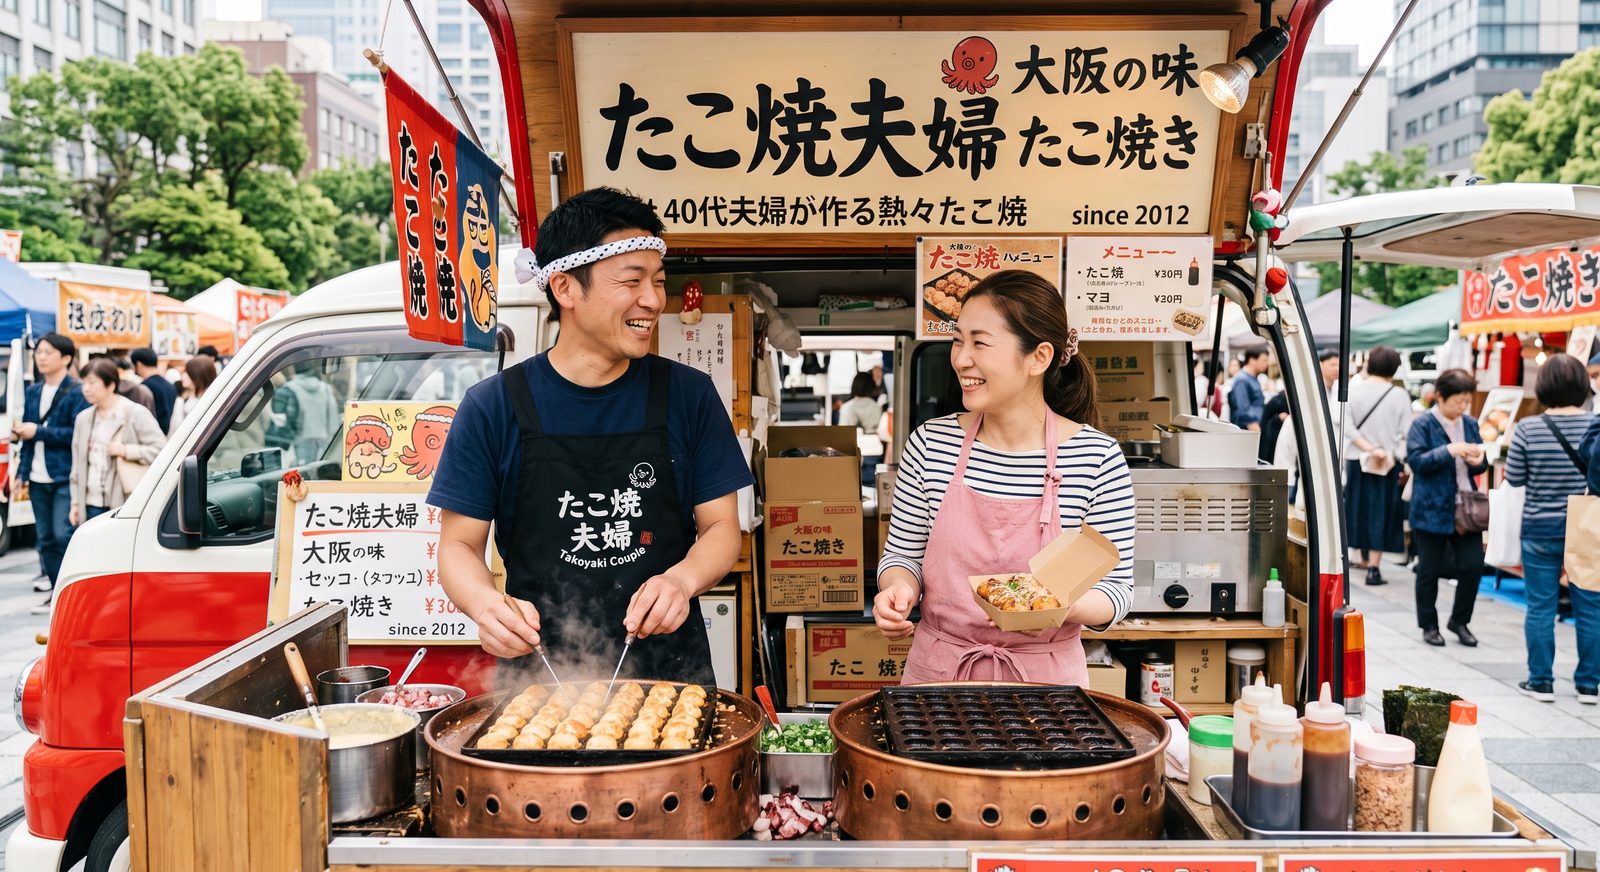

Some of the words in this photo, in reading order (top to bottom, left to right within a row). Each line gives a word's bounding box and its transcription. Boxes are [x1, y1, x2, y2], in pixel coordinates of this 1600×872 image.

[1011, 44, 1200, 96] 大阪の味
[599, 77, 1006, 181] たこ焼夫婦
[1019, 113, 1199, 171] たこ焼き
[397, 121, 428, 319] たこ焼
[1072, 206, 1129, 226] since
[1135, 204, 1190, 226] 2012
[929, 244, 1000, 270] たこ焼
[1486, 252, 1600, 311] たこ焼き
[305, 502, 419, 529] たこ焼夫婦
[557, 487, 643, 519] たこ焼
[570, 520, 633, 552] 夫婦
[782, 538, 845, 555] たこ焼き
[302, 540, 386, 565] 大阪の味
[560, 549, 607, 569] Takoyaki
[609, 546, 646, 566] Couple
[388, 623, 427, 636] since
[431, 622, 466, 636] 2012
